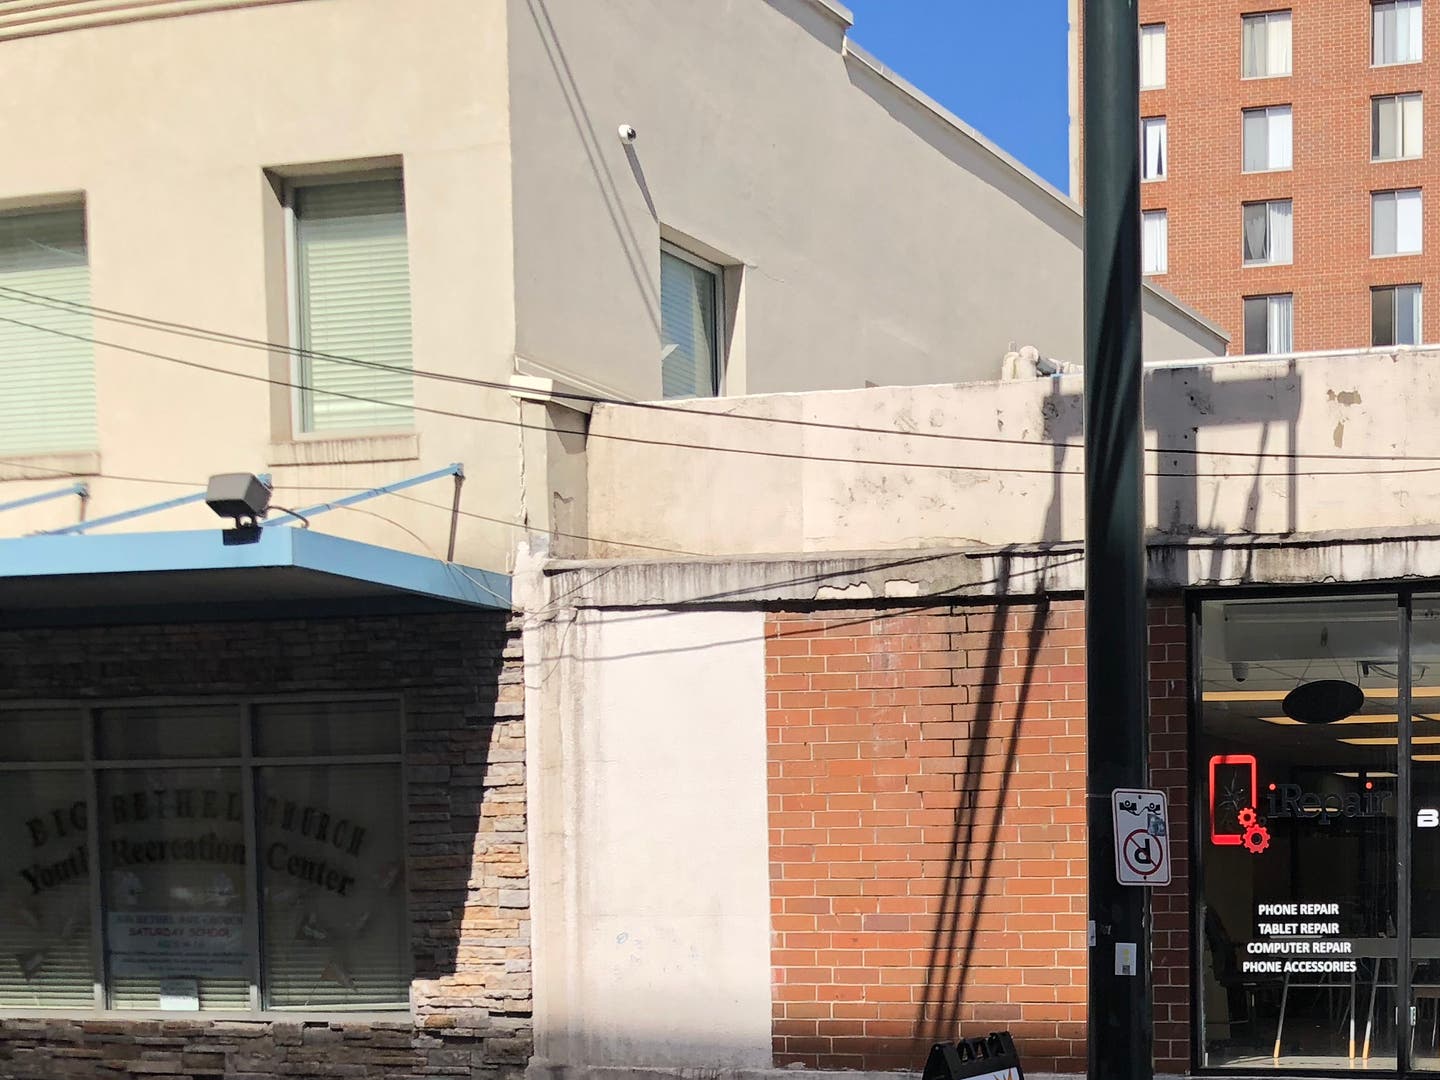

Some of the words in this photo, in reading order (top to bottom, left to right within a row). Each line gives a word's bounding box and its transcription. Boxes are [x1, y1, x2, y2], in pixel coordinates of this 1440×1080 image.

[1267, 780, 1393, 825] iRepair
[25, 801, 89, 848] BIG
[111, 790, 244, 825] BETHEL
[265, 794, 368, 858] CHURCH
[20, 843, 90, 895] Youth
[111, 831, 246, 867] Recreation
[266, 840, 356, 897] Center
[1258, 904, 1298, 915] PHONE
[1300, 904, 1340, 915] REPAIR
[1258, 923, 1298, 935] TABLET
[1300, 922, 1340, 934] REPAIR
[1247, 942, 1310, 954] COMPUTER
[1312, 942, 1352, 953] REPAIR
[1242, 961, 1282, 973] PHONE
[1284, 961, 1357, 973] ACCESSORIES
